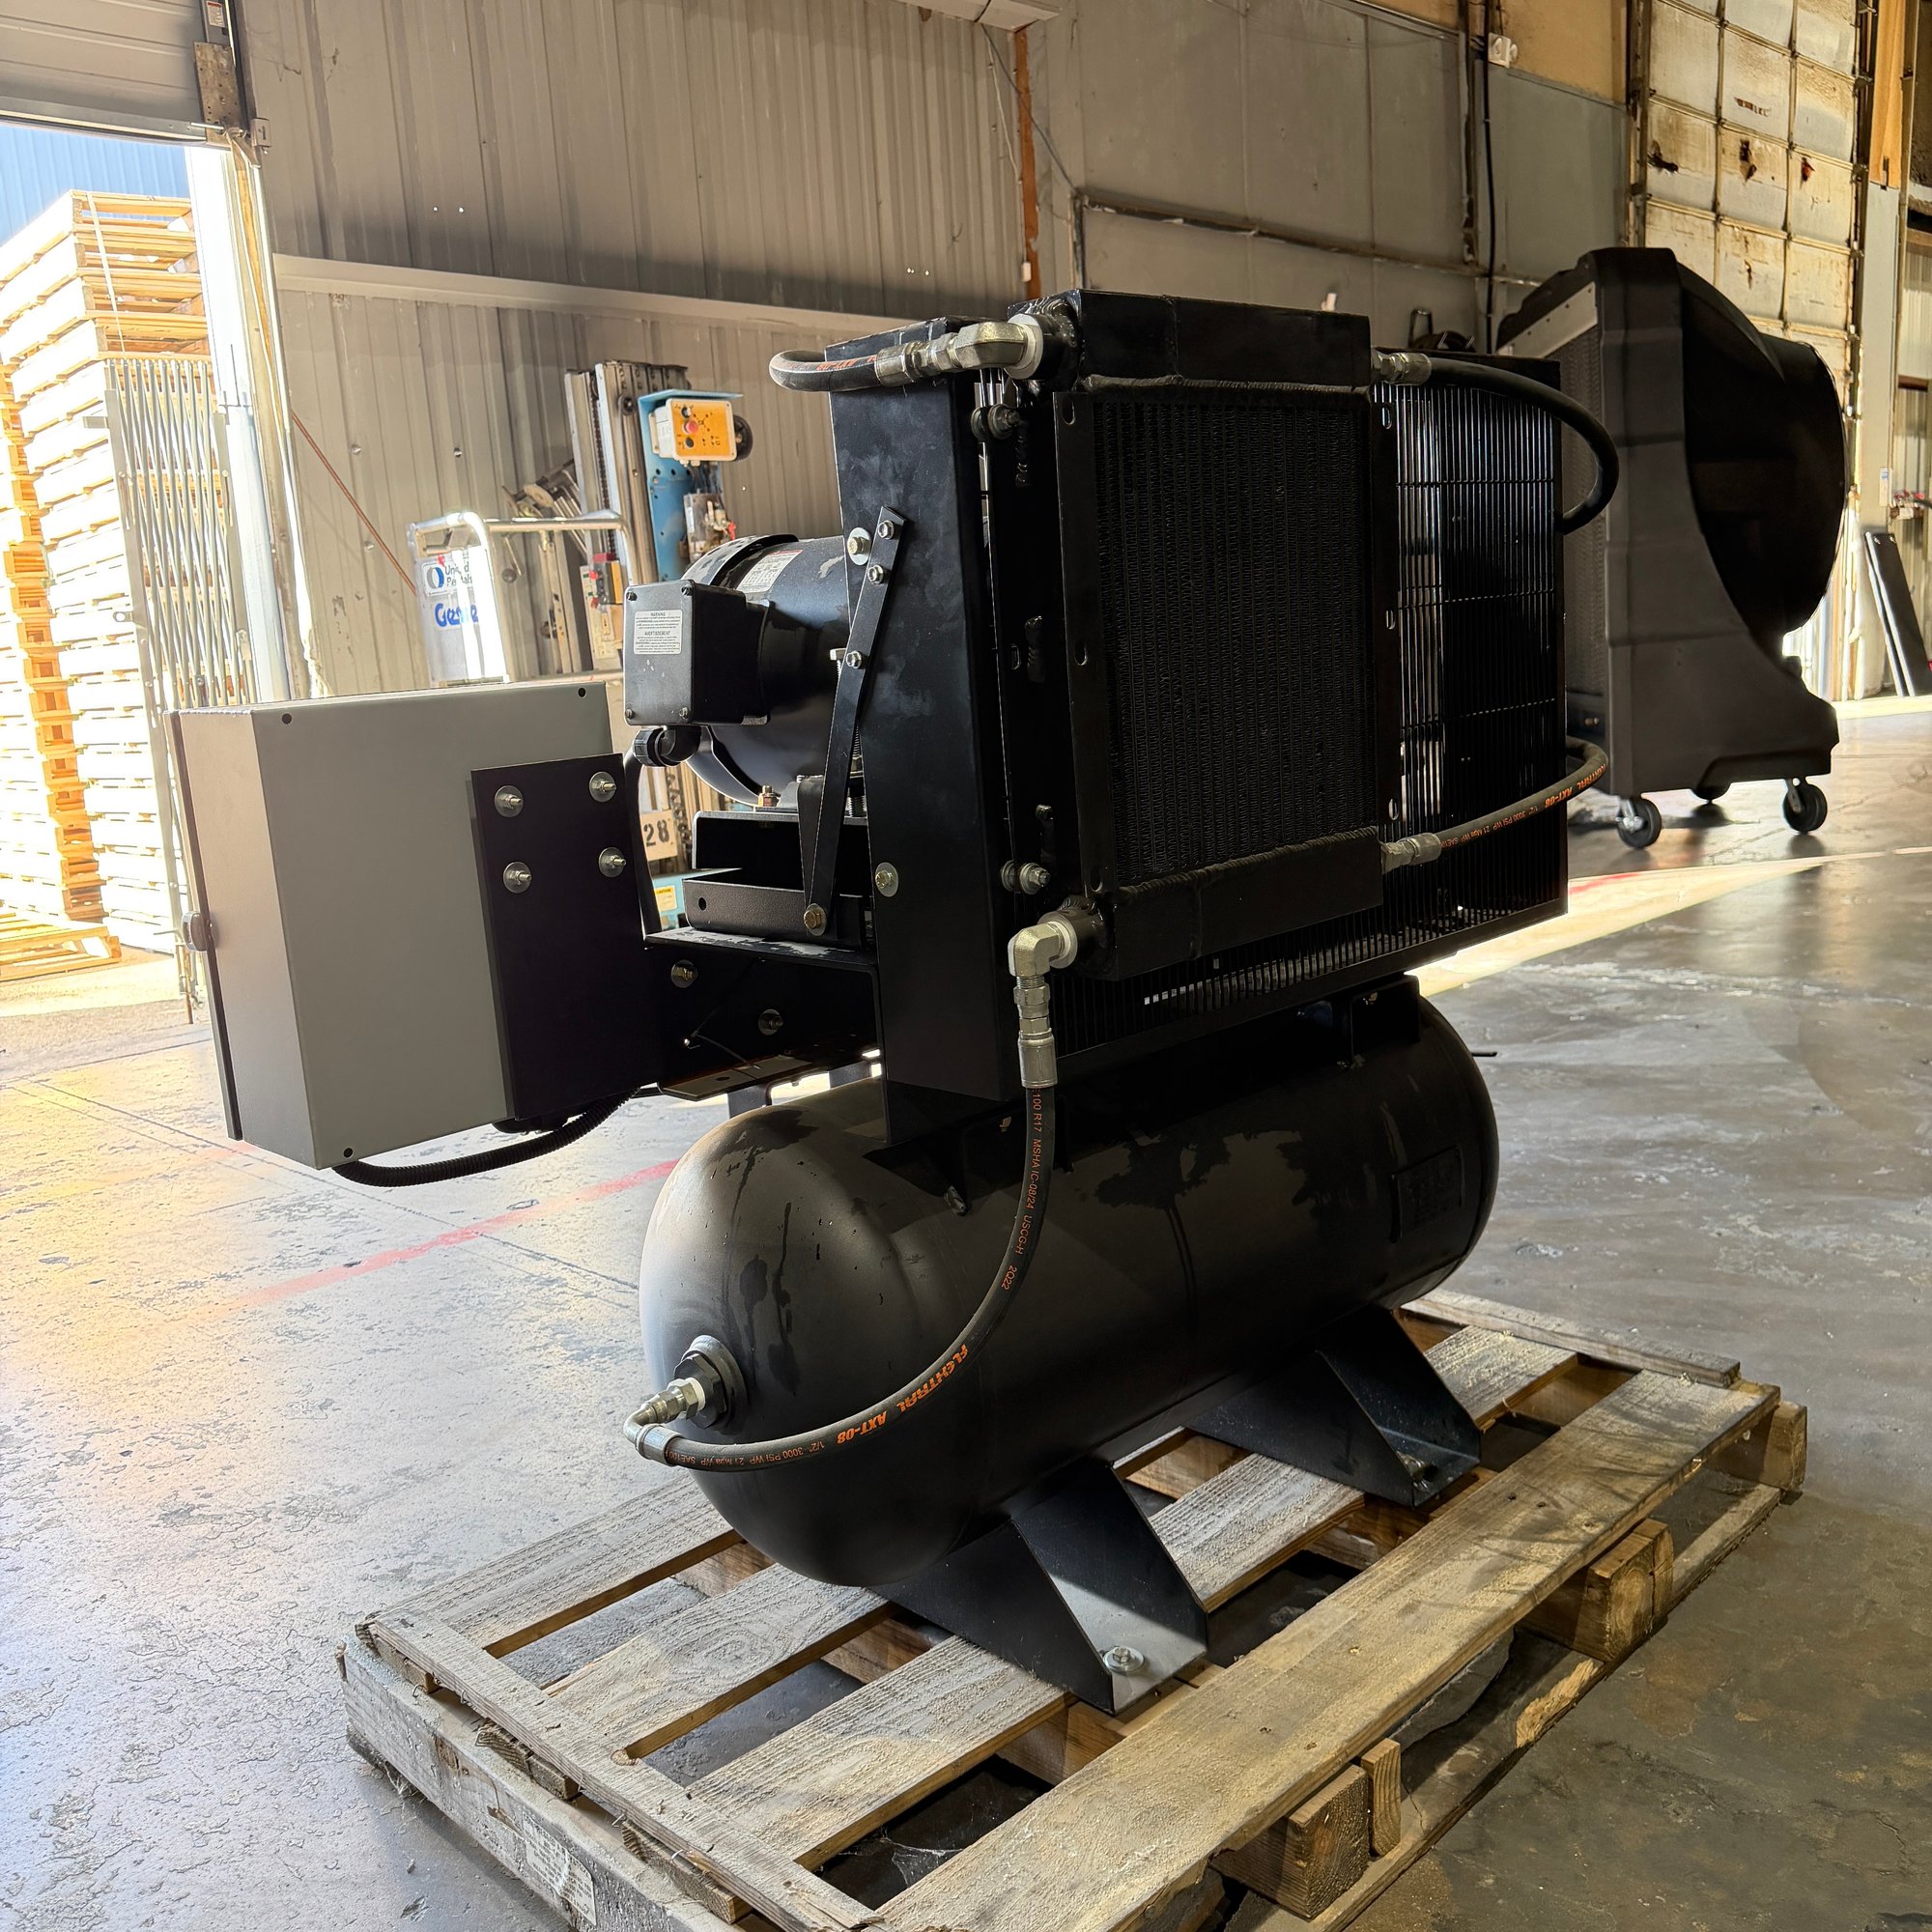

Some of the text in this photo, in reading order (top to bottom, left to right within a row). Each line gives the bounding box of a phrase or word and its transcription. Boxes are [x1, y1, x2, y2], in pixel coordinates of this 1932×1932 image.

[643, 819, 670, 847] 28
[1033, 1113, 1043, 1133] R17
[1032, 1138, 1042, 1168] MSHA
[1026, 1170, 1040, 1209] IC-08/24
[1015, 1214, 1033, 1255] USCG-H
[896, 1344, 968, 1412] FLEXTRAL
[837, 1410, 888, 1444] AXT-08
[749, 1454, 765, 1464] WP
[766, 1452, 782, 1463] PSI
[783, 1446, 804, 1460] 3000
